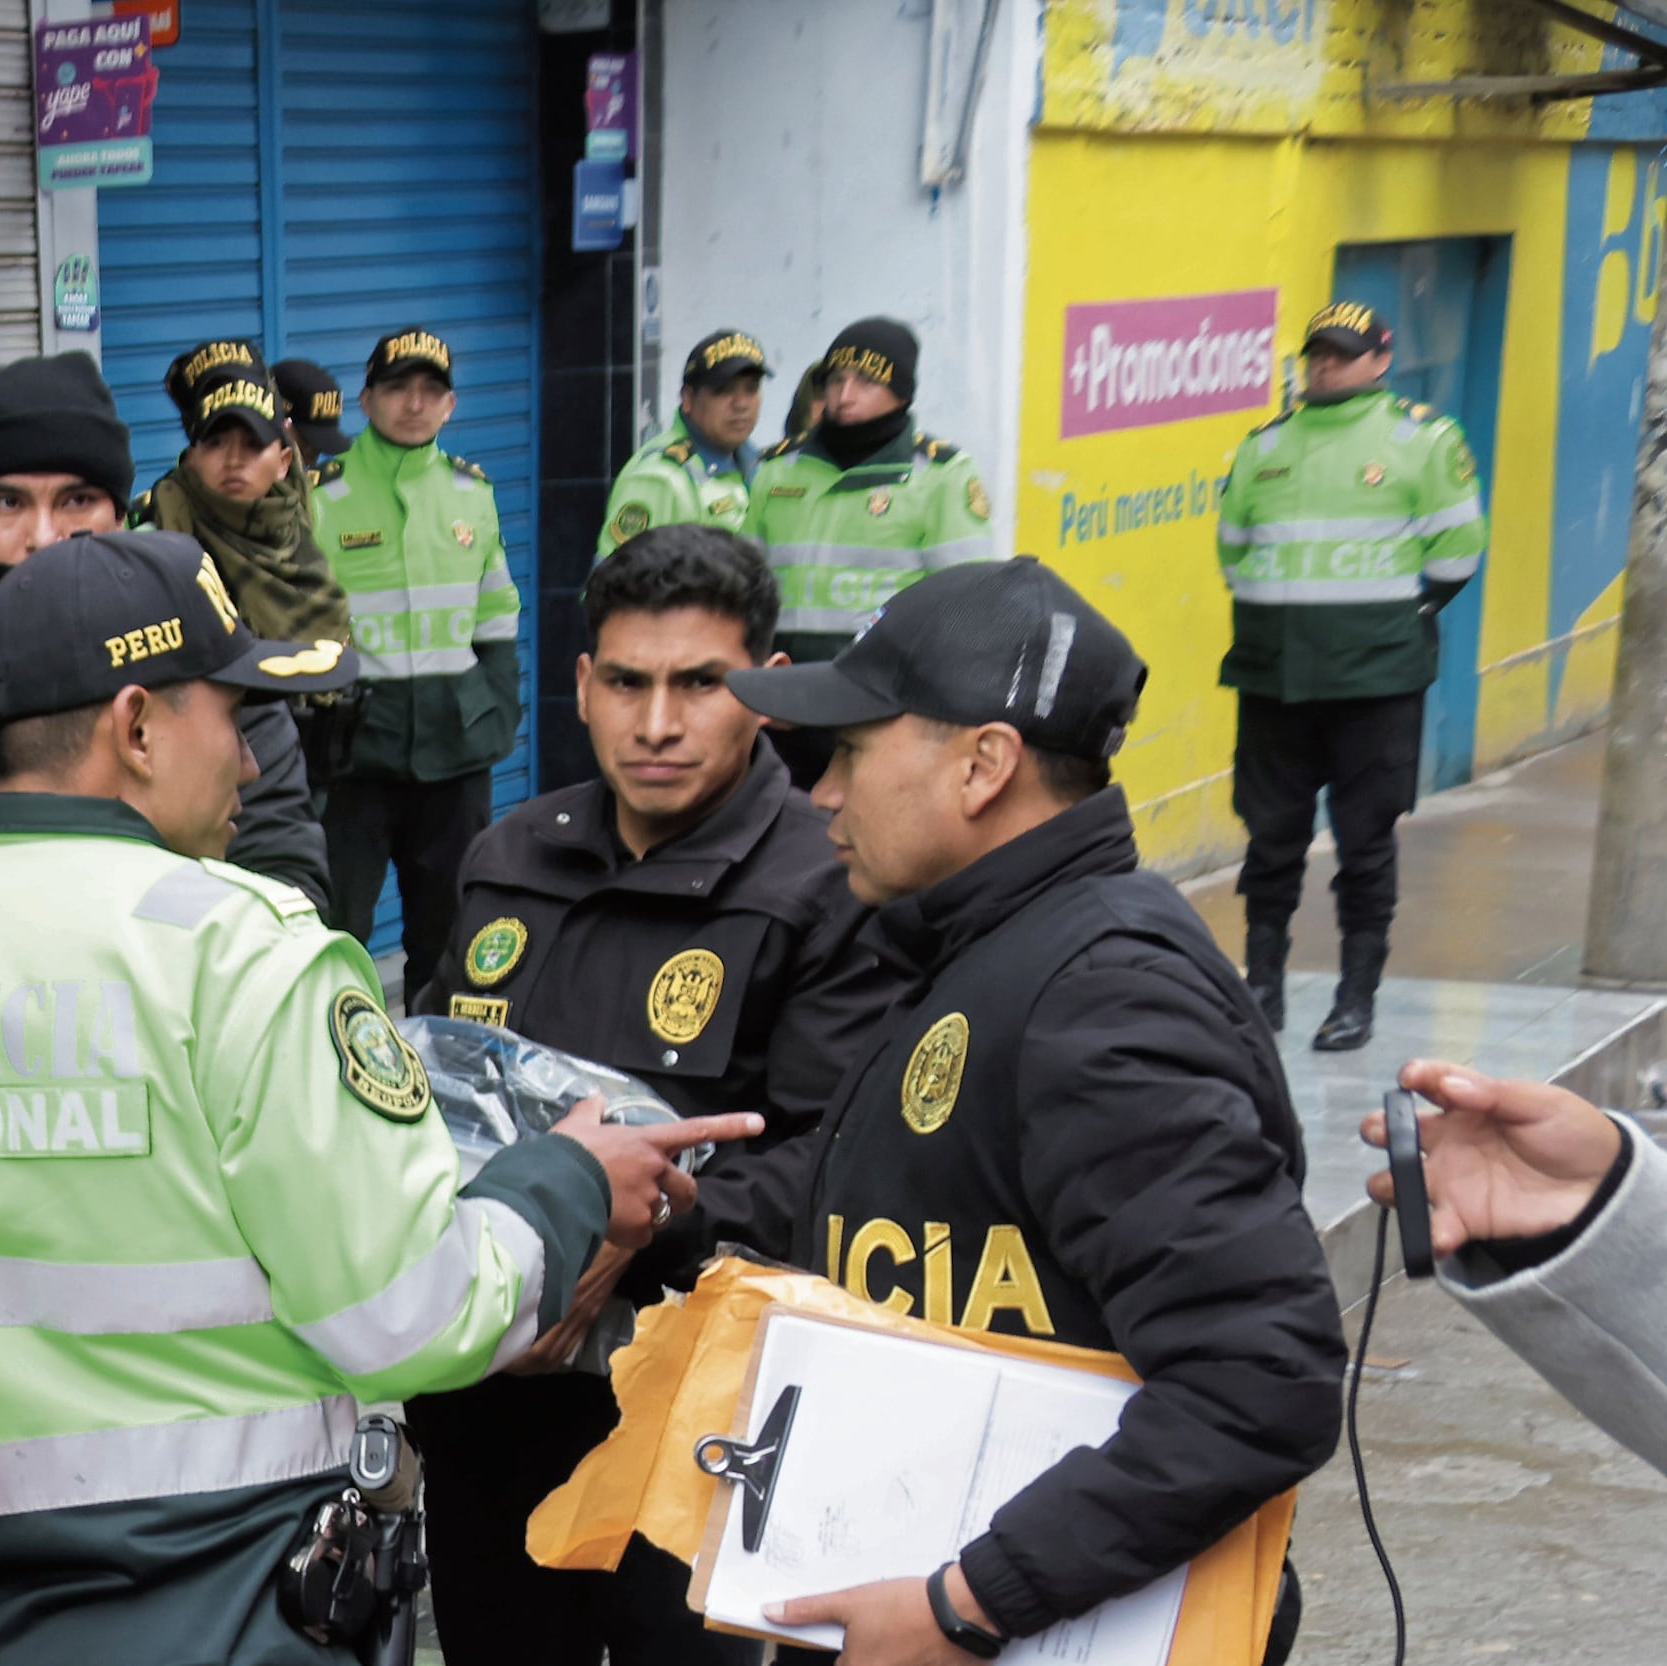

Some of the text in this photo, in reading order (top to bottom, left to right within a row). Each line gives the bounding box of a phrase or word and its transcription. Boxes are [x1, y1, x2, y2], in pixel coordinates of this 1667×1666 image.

[42, 26, 92, 50] PAGA
[94, 48, 134, 72] CON
[40, 81, 92, 134] yape
[185, 342, 253, 388] POLICIA
[386, 331, 449, 370] POLICIA
[202, 380, 275, 419] POLICIA
[1059, 483, 1108, 549] Perú
[105, 617, 184, 668] PERU
